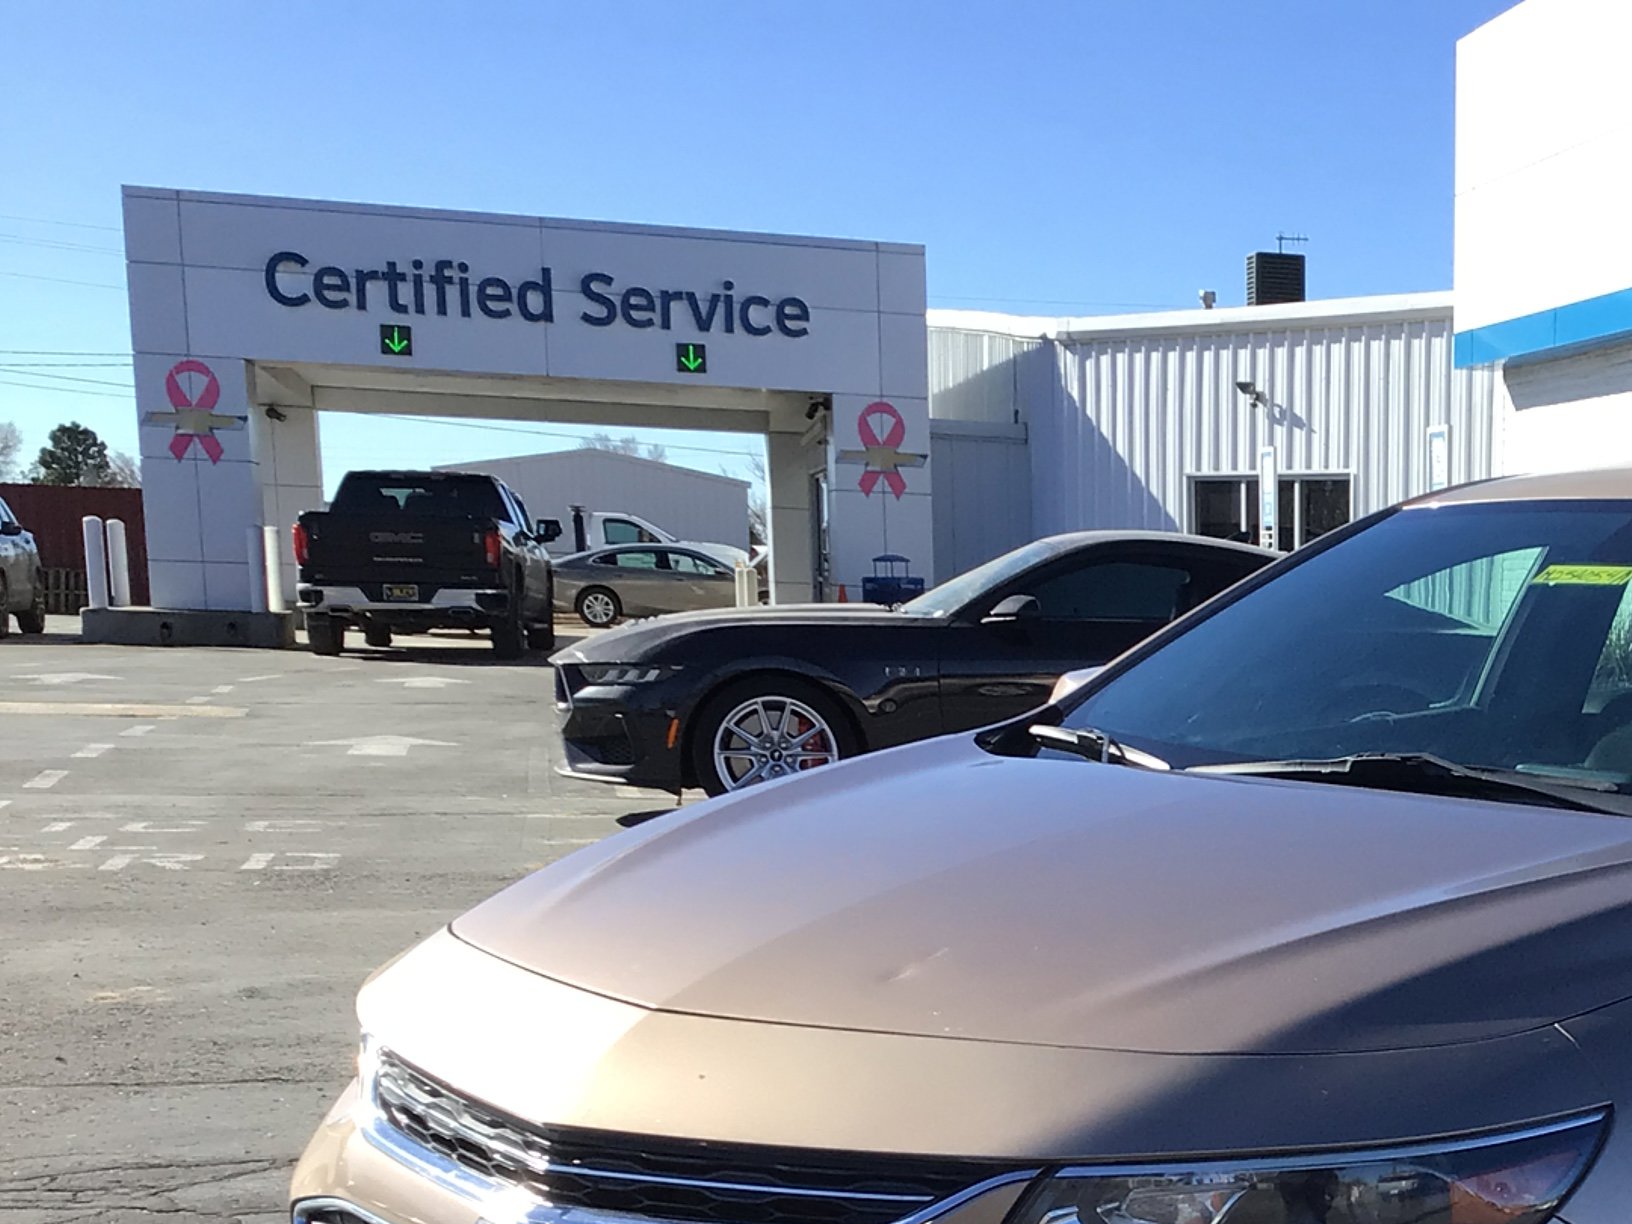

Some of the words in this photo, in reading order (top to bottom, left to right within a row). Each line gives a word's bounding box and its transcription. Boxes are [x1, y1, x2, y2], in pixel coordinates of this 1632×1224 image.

[264, 251, 555, 324] Certified
[580, 271, 812, 338] Service
[369, 532, 424, 544] GMC
